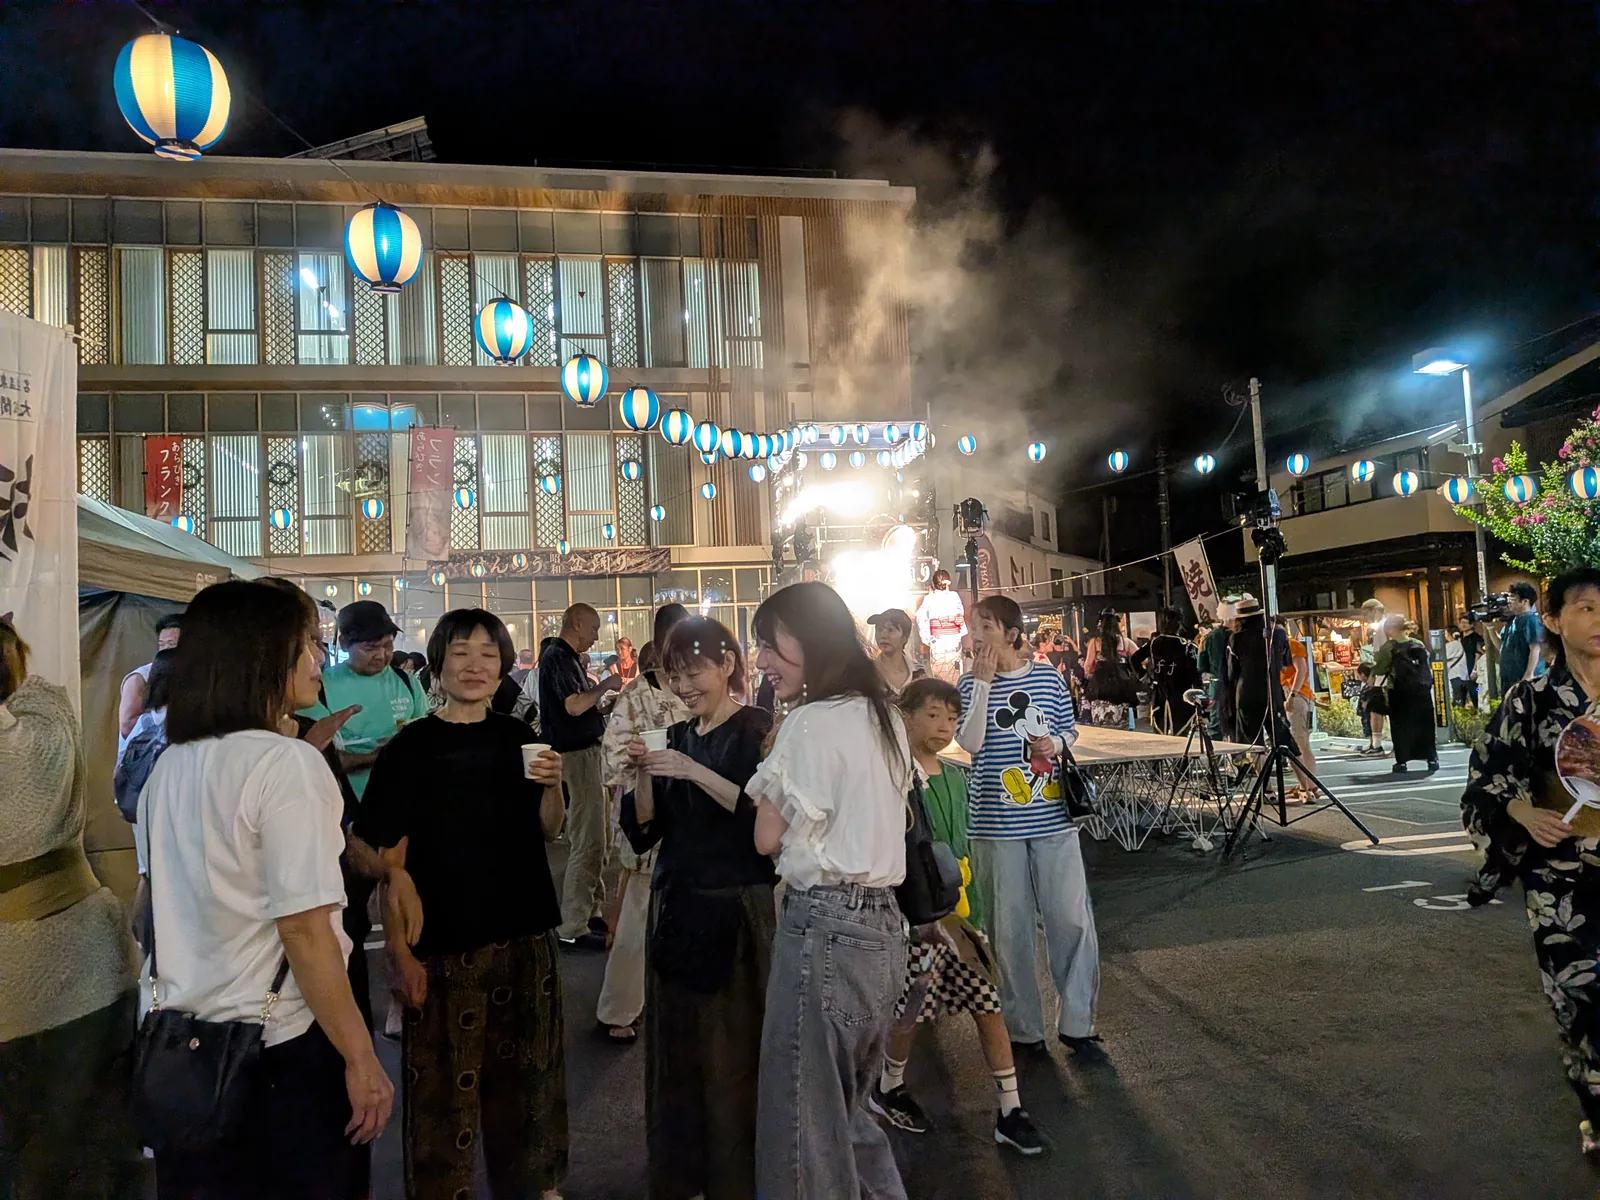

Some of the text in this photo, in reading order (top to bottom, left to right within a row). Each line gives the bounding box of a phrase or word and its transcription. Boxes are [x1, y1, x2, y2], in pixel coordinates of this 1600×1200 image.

[160, 449, 172, 515] フランク
[171, 441, 181, 486] あらびき
